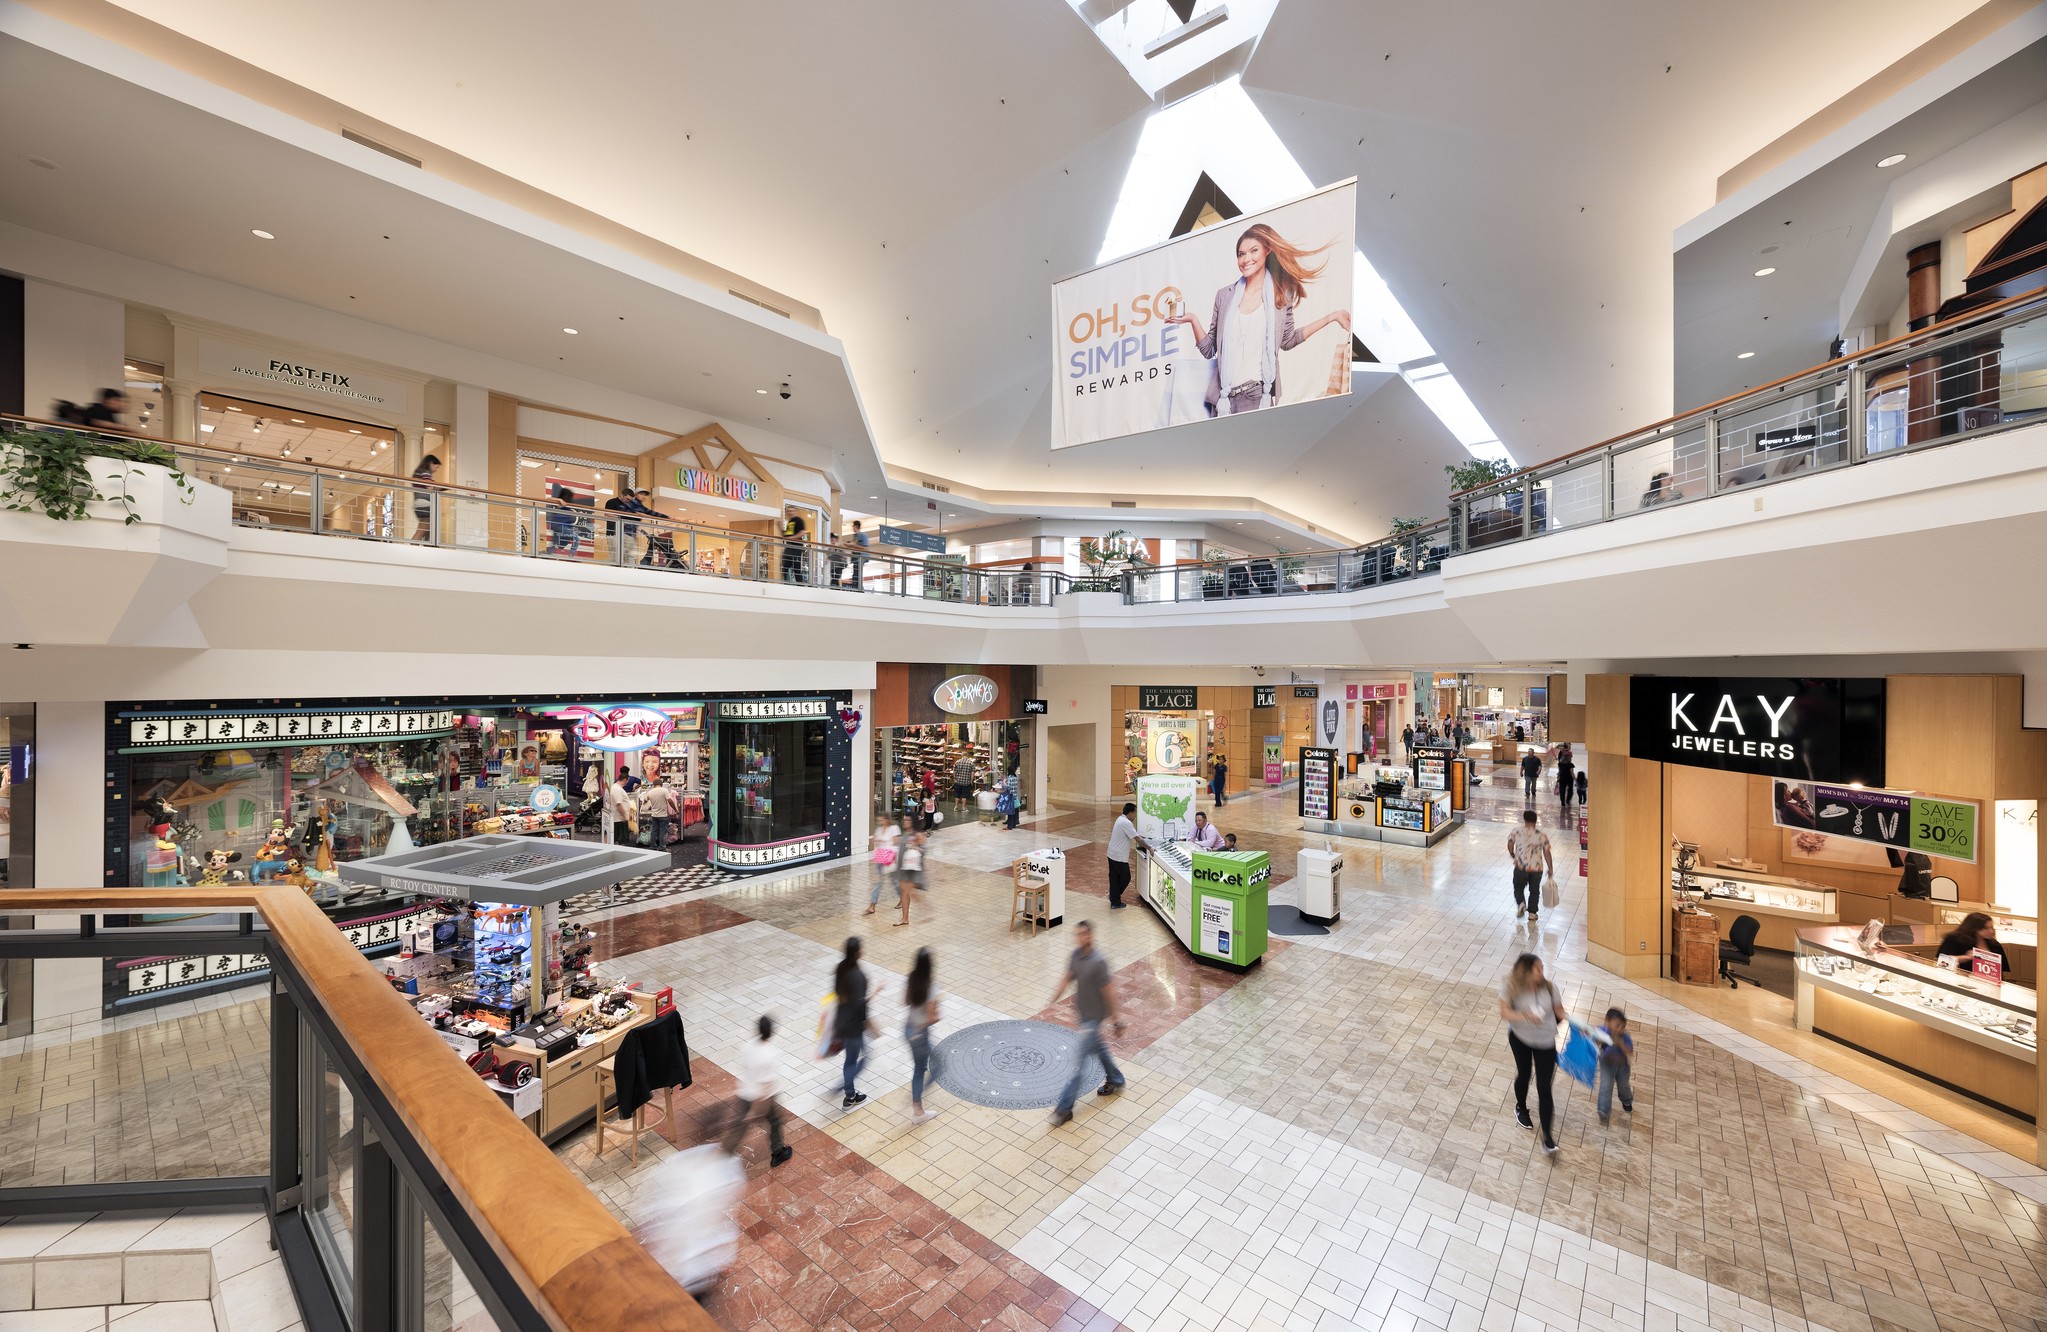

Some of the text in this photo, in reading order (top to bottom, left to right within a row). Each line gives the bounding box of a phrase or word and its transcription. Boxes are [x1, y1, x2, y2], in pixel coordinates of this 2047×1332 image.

[1068, 285, 1184, 345] OH, SO
[1069, 323, 1181, 379] SIMPLE
[232, 365, 279, 382] JEWELRY
[281, 376, 305, 387] AND
[305, 381, 342, 396] WATCH
[268, 359, 350, 388] FAST-FIX
[1075, 362, 1173, 397] REWARDS
[1145, 694, 1194, 708] PLACE
[1157, 720, 1173, 728] SHORTS
[1671, 692, 1796, 738] KAY
[1671, 734, 1795, 760] JEWELERS
[1817, 787, 1837, 797] MOM'S
[1837, 790, 1849, 798] DAY
[1857, 793, 1883, 803] SUNDAY
[1883, 796, 1899, 805] MAY
[1900, 799, 1910, 807] 14
[1920, 802, 1965, 822] SAVE
[1928, 816, 1955, 828] UP TO
[1918, 823, 1968, 846] 30%
[1913, 842, 1936, 850] Diamond
[1193, 868, 1243, 888] cricket
[1248, 864, 1272, 887] cricket
[390, 878, 459, 897] RC TOY CENTER
[1202, 912, 1221, 924] FREE
[1976, 962, 1998, 975] 10%
